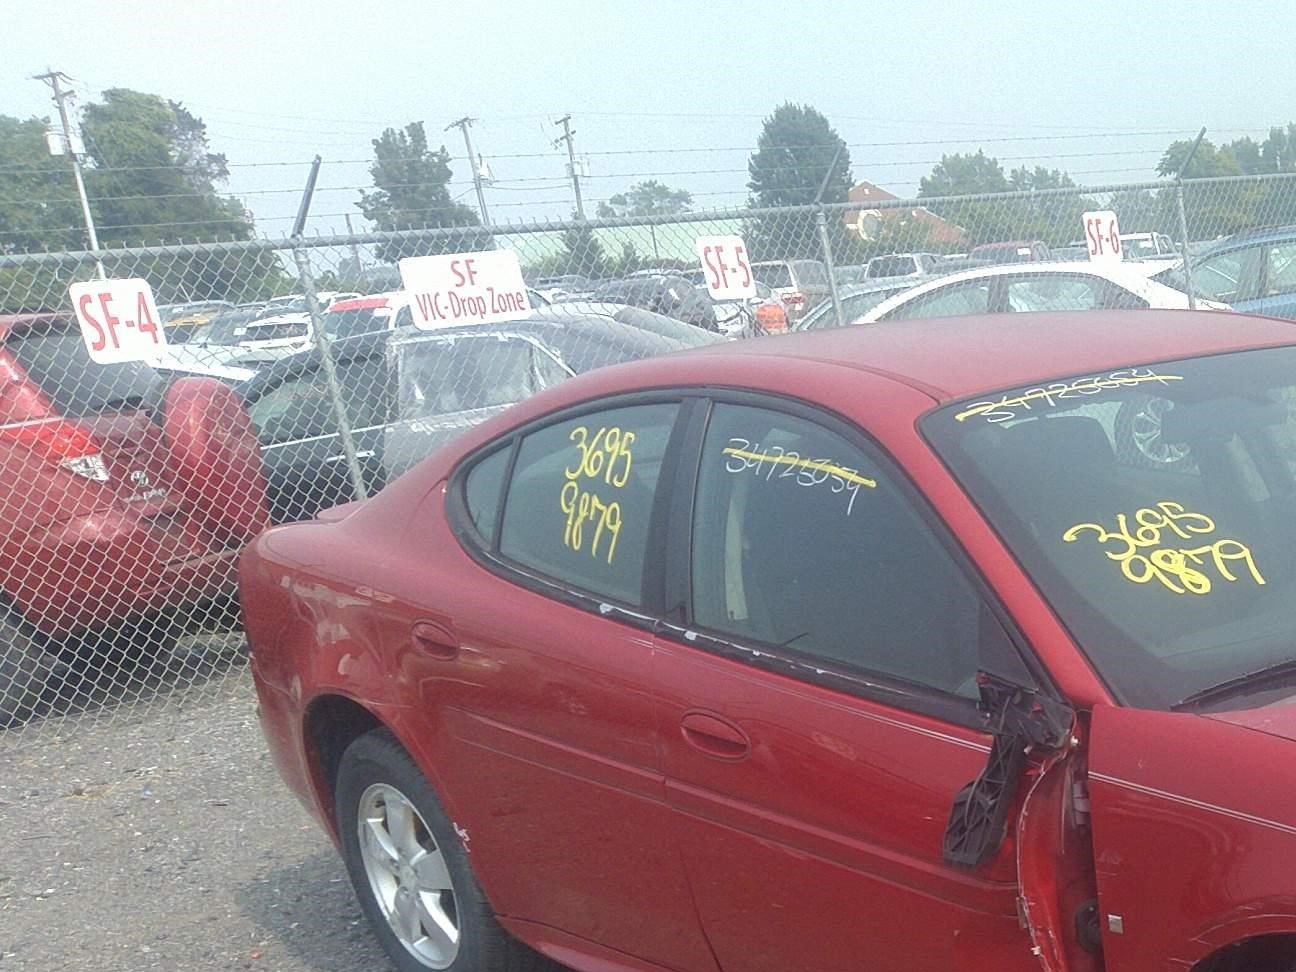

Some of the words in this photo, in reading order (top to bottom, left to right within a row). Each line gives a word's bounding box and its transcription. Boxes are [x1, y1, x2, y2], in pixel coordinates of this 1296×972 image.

[1087, 218, 1119, 256] SF-6
[450, 258, 477, 287] SF
[703, 245, 750, 290] SF-5
[80, 291, 158, 351] SF-4
[415, 290, 487, 321] VIC-Drop
[486, 286, 526, 314] Zone
[565, 426, 636, 488] 3695
[560, 480, 622, 565] 9879
[1063, 501, 1216, 561] 3695
[1120, 539, 1266, 595] 9879
